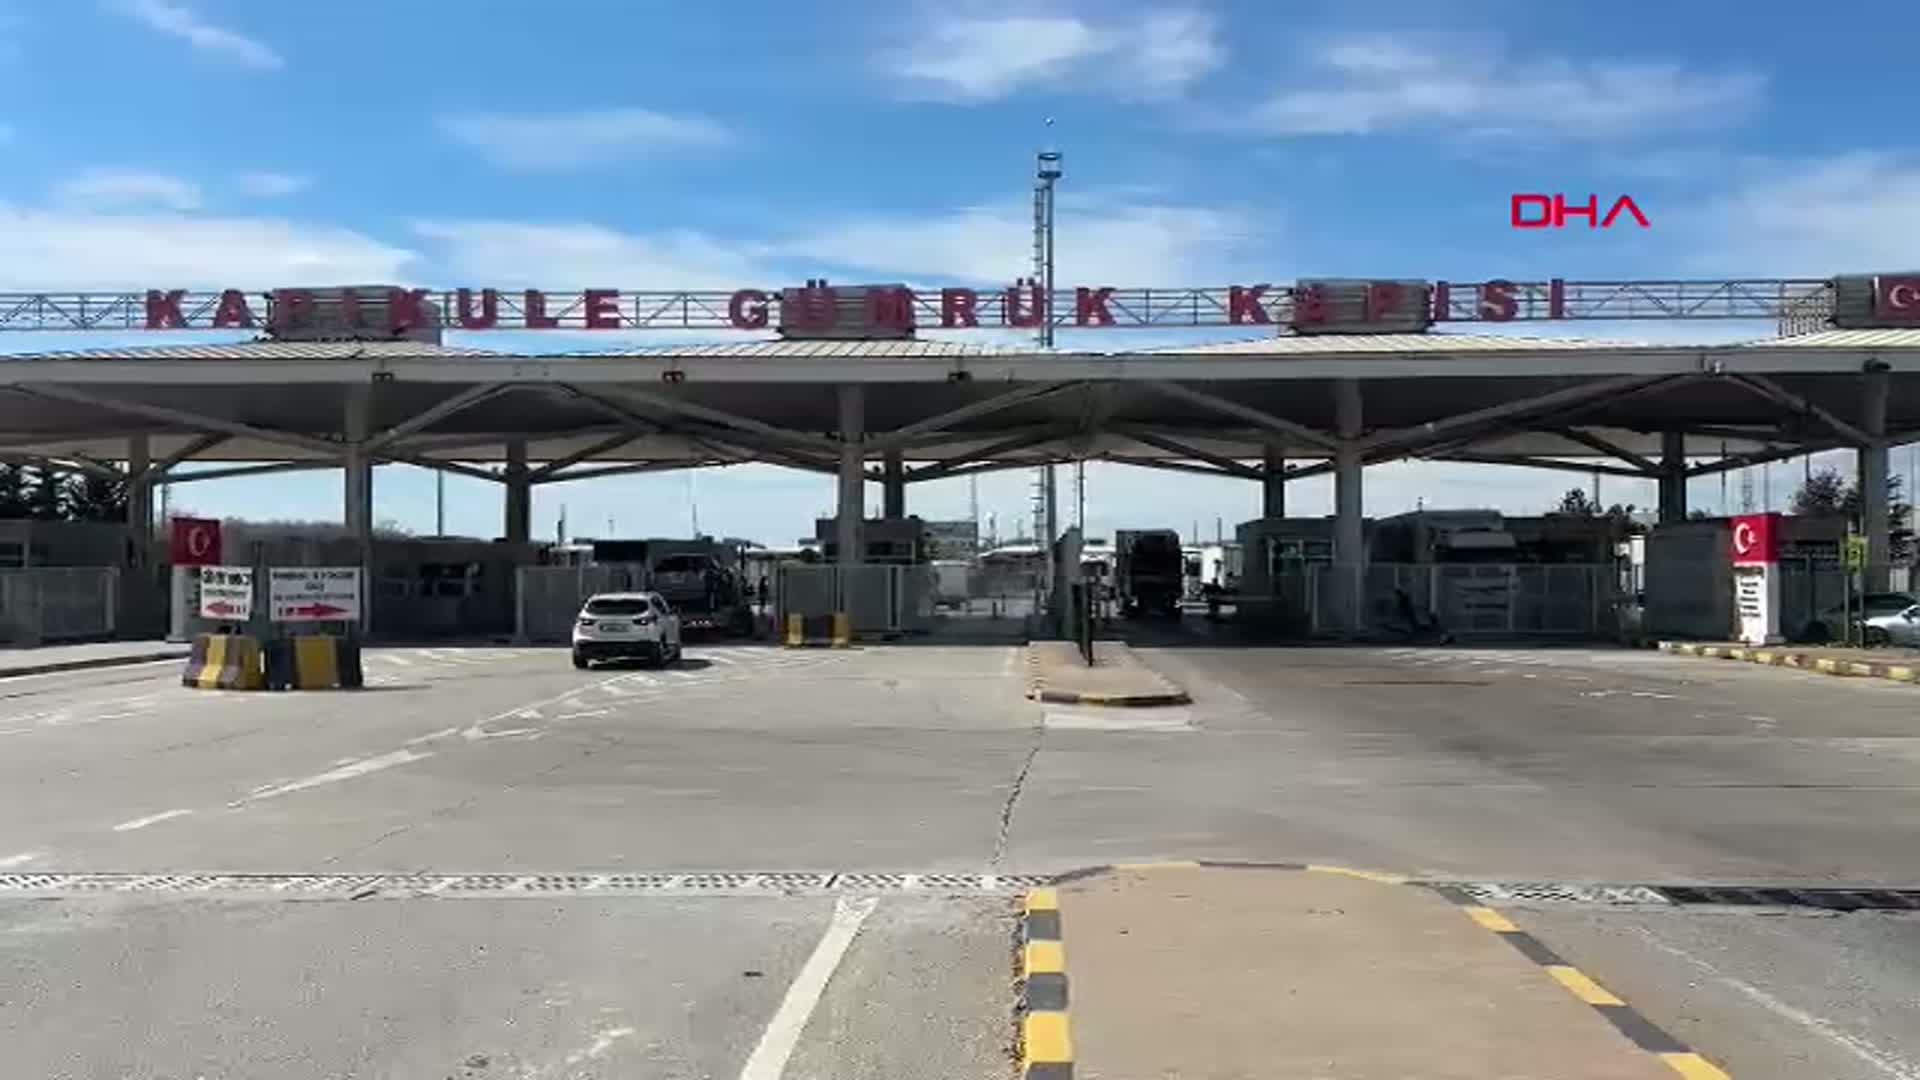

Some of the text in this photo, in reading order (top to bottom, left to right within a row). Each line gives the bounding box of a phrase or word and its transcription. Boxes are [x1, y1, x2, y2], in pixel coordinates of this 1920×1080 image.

[145, 277, 1566, 328] KAPIKULE GÜMRÜK KAPISI
